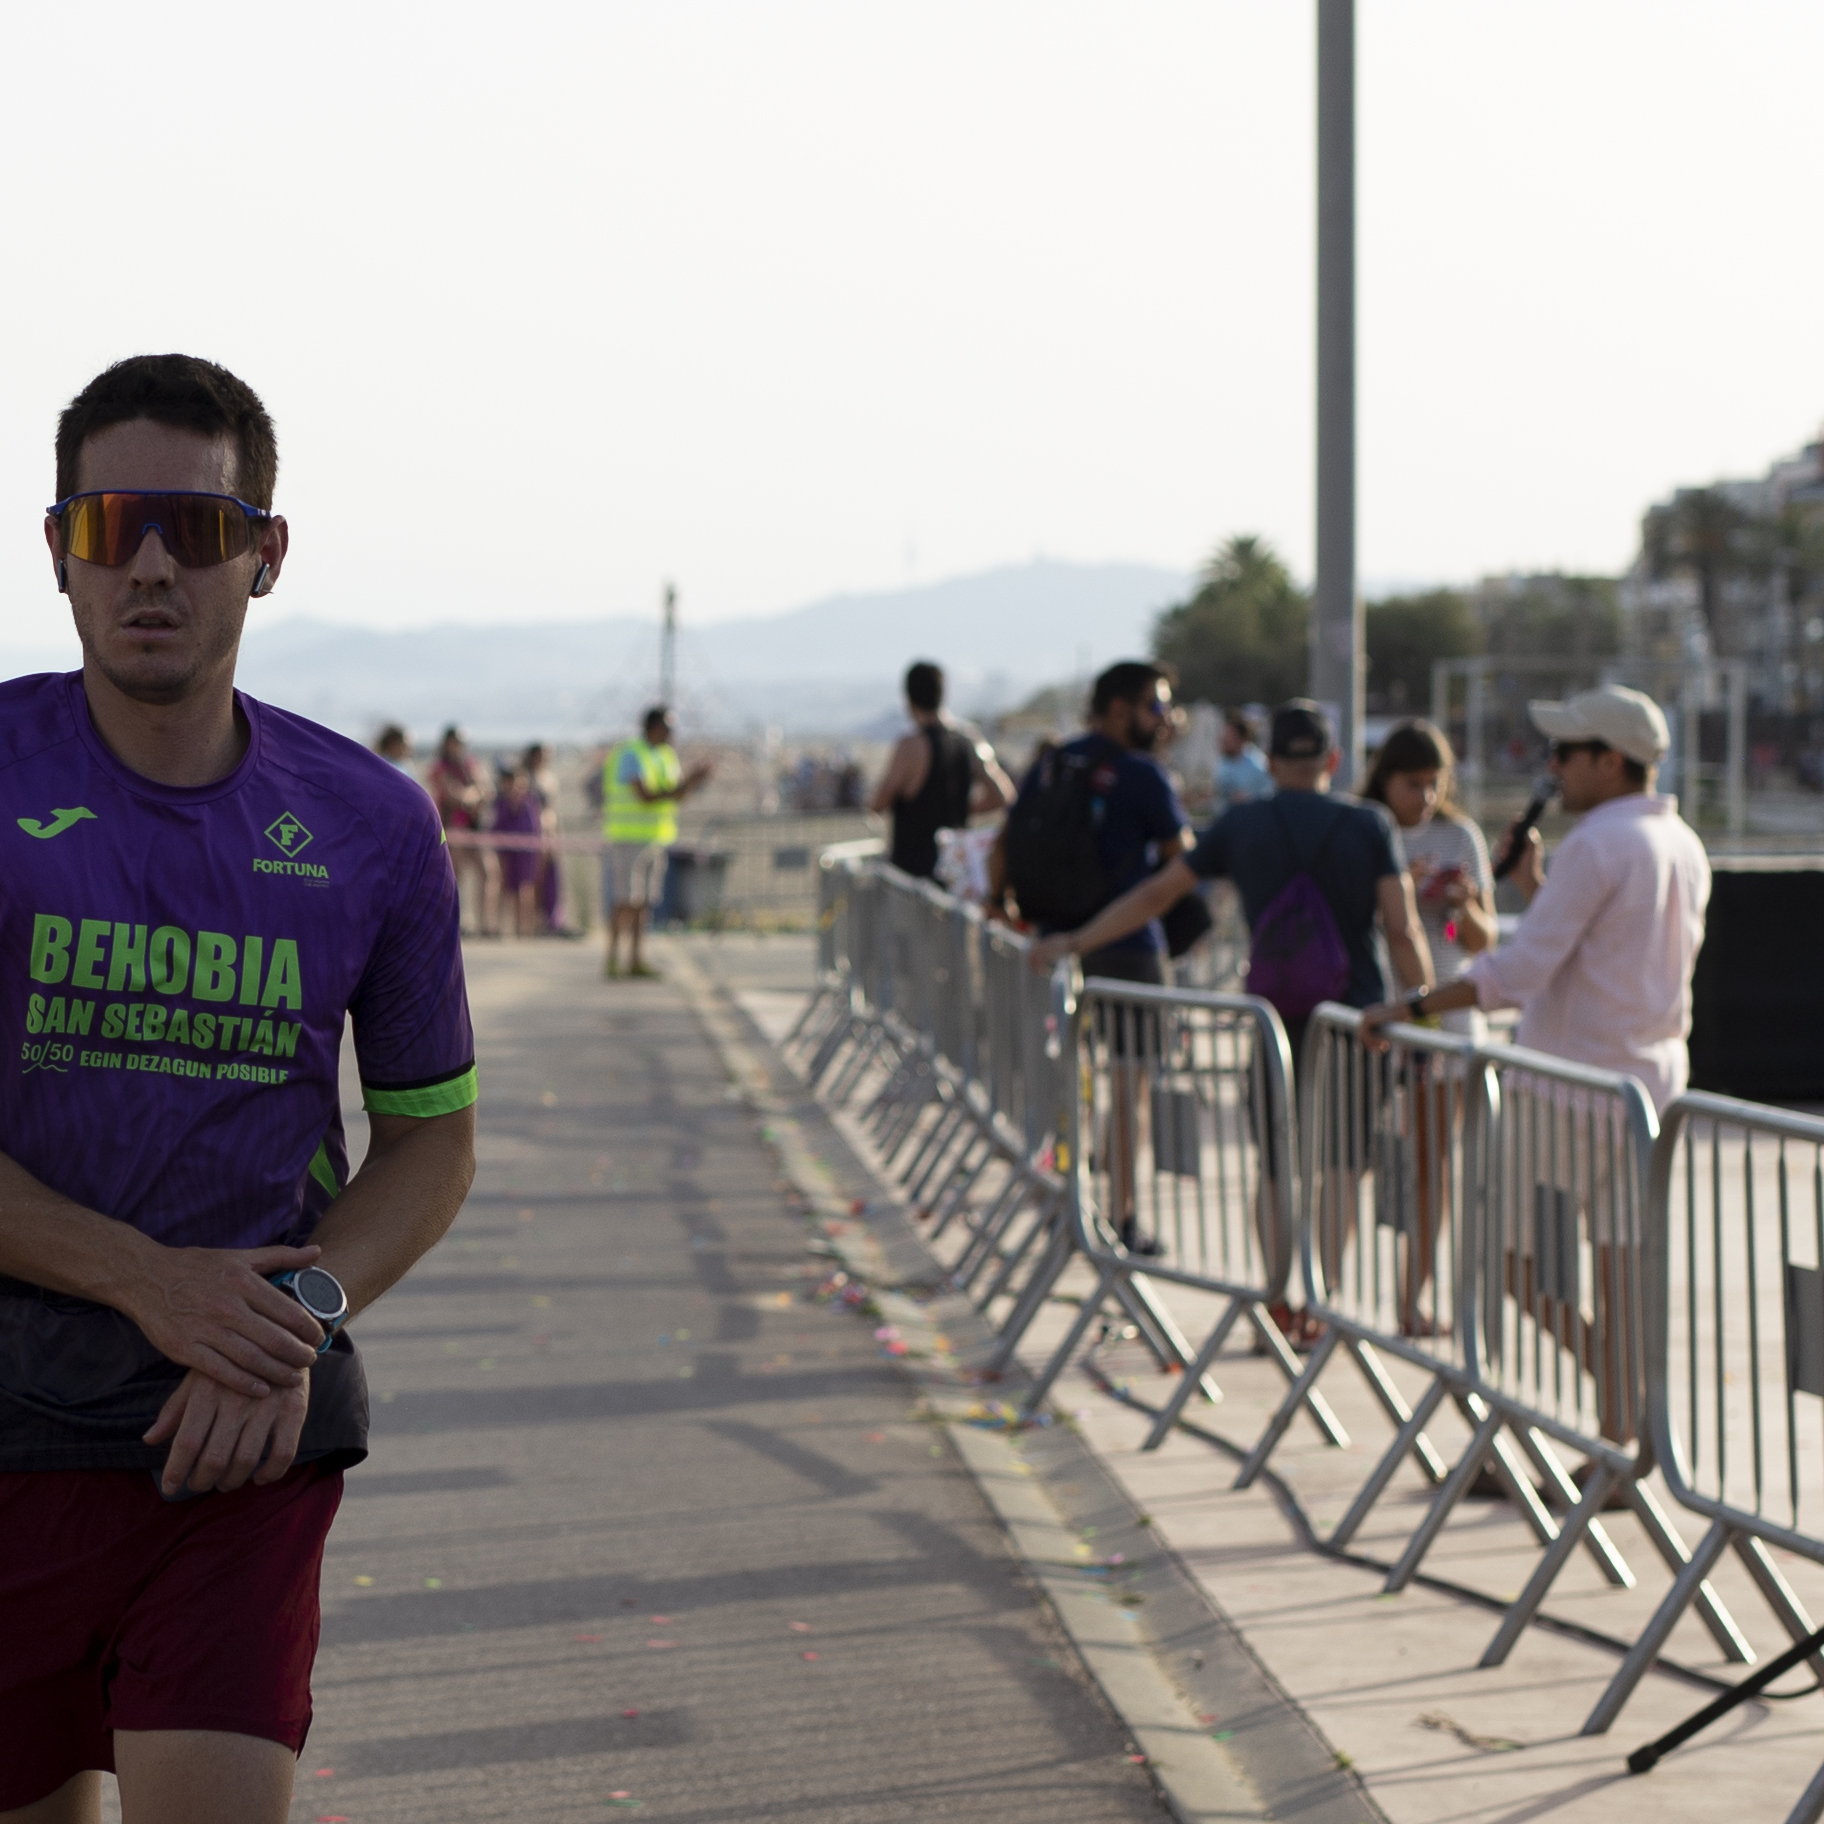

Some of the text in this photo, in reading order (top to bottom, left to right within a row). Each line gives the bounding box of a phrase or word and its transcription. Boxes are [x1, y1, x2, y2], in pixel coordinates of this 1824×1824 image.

[279, 823, 299, 846] F
[253, 858, 329, 879] FORTUNA
[29, 912, 303, 1011] BEHOBIA
[25, 992, 303, 1059] SAN SEBASTIÁN
[20, 1039, 290, 1086] 50/50 EGIN DEZAGUN POSIBLE
